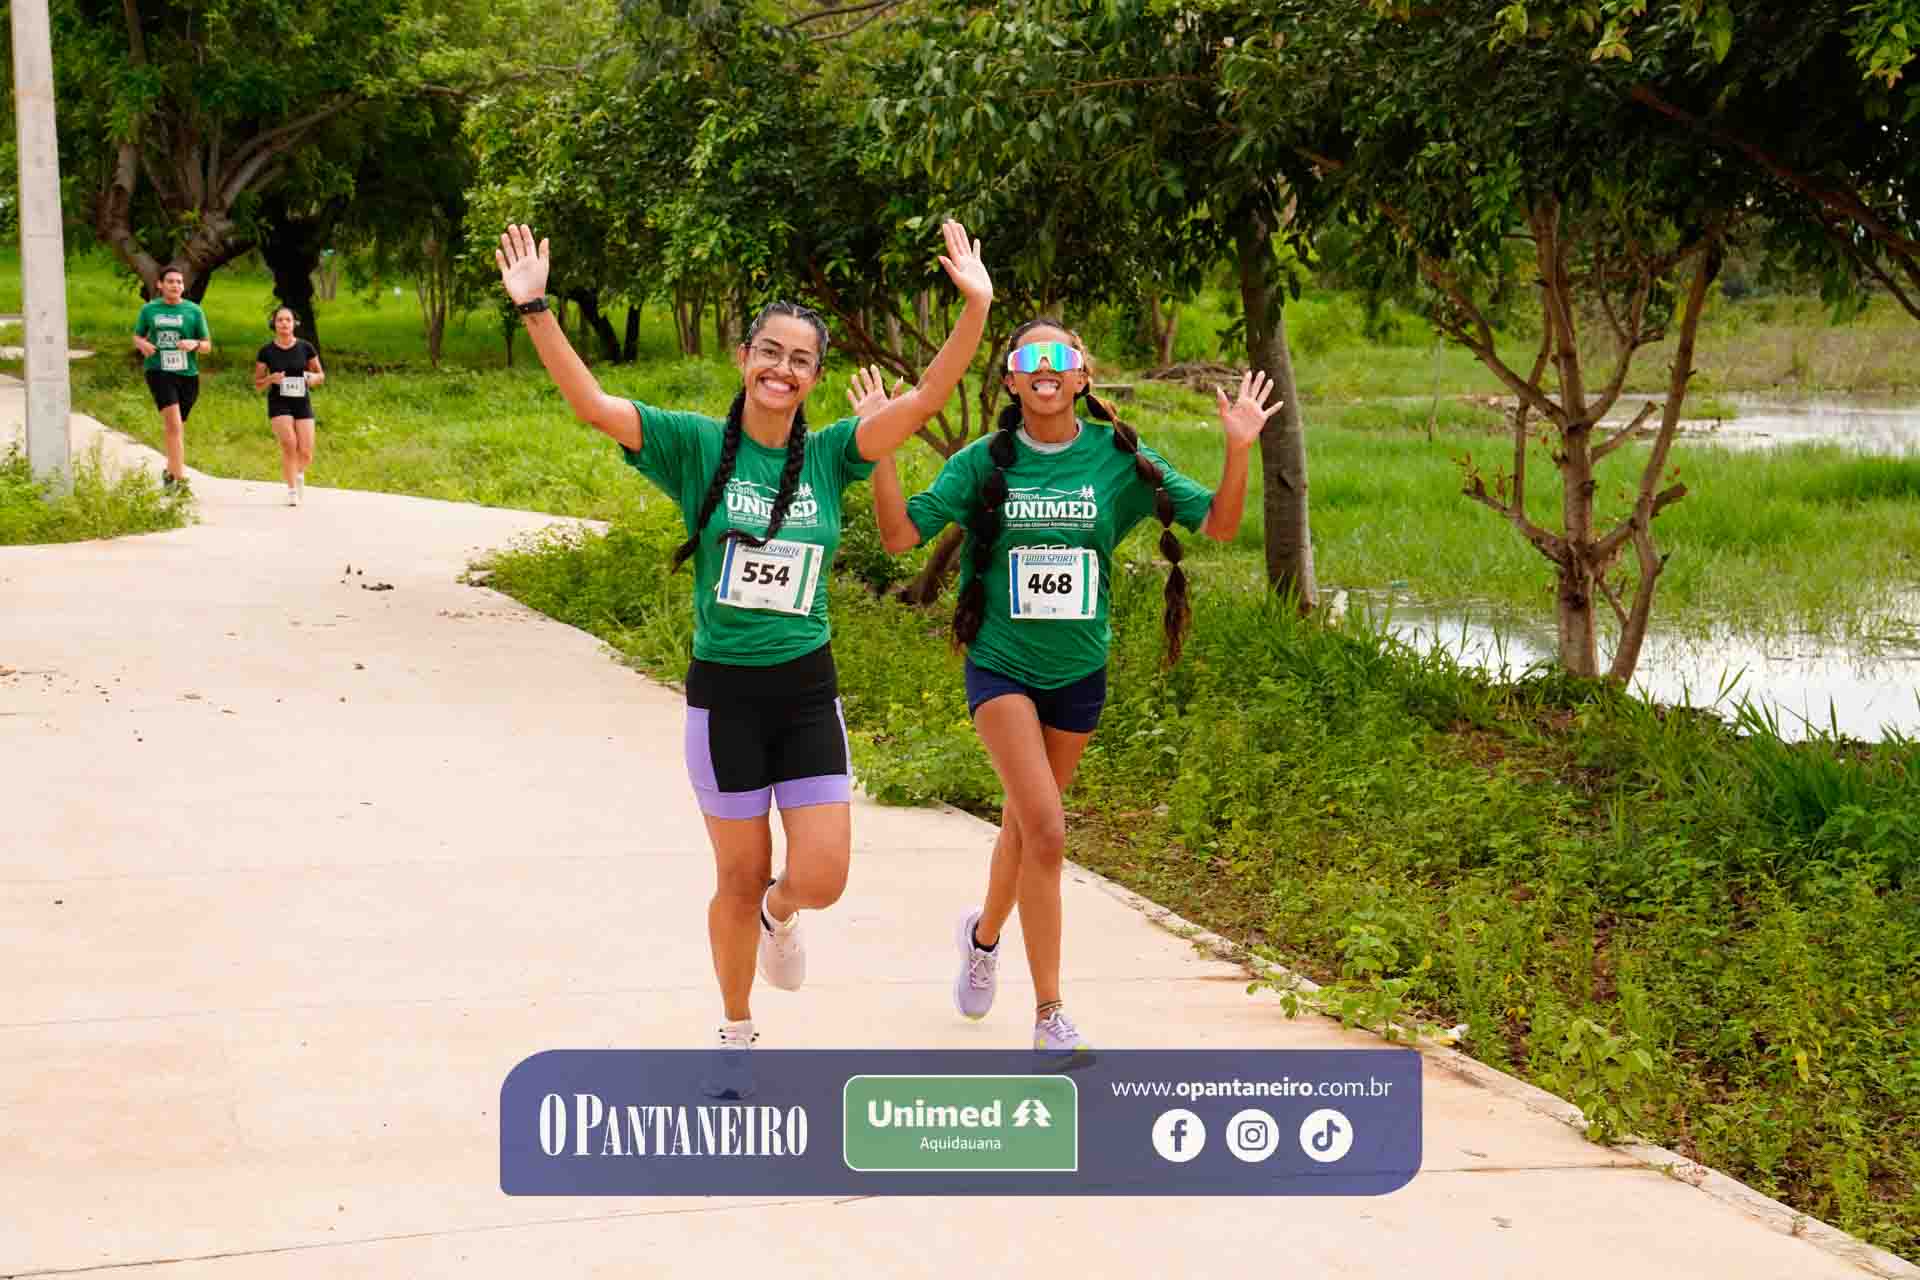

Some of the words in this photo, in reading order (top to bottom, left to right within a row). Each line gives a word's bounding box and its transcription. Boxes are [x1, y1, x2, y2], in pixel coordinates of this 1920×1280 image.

[1009, 493, 1040, 501] ORRIDA
[1004, 501, 1098, 519] UNIMED
[741, 561, 790, 587] 554
[1028, 573, 1072, 594] 468
